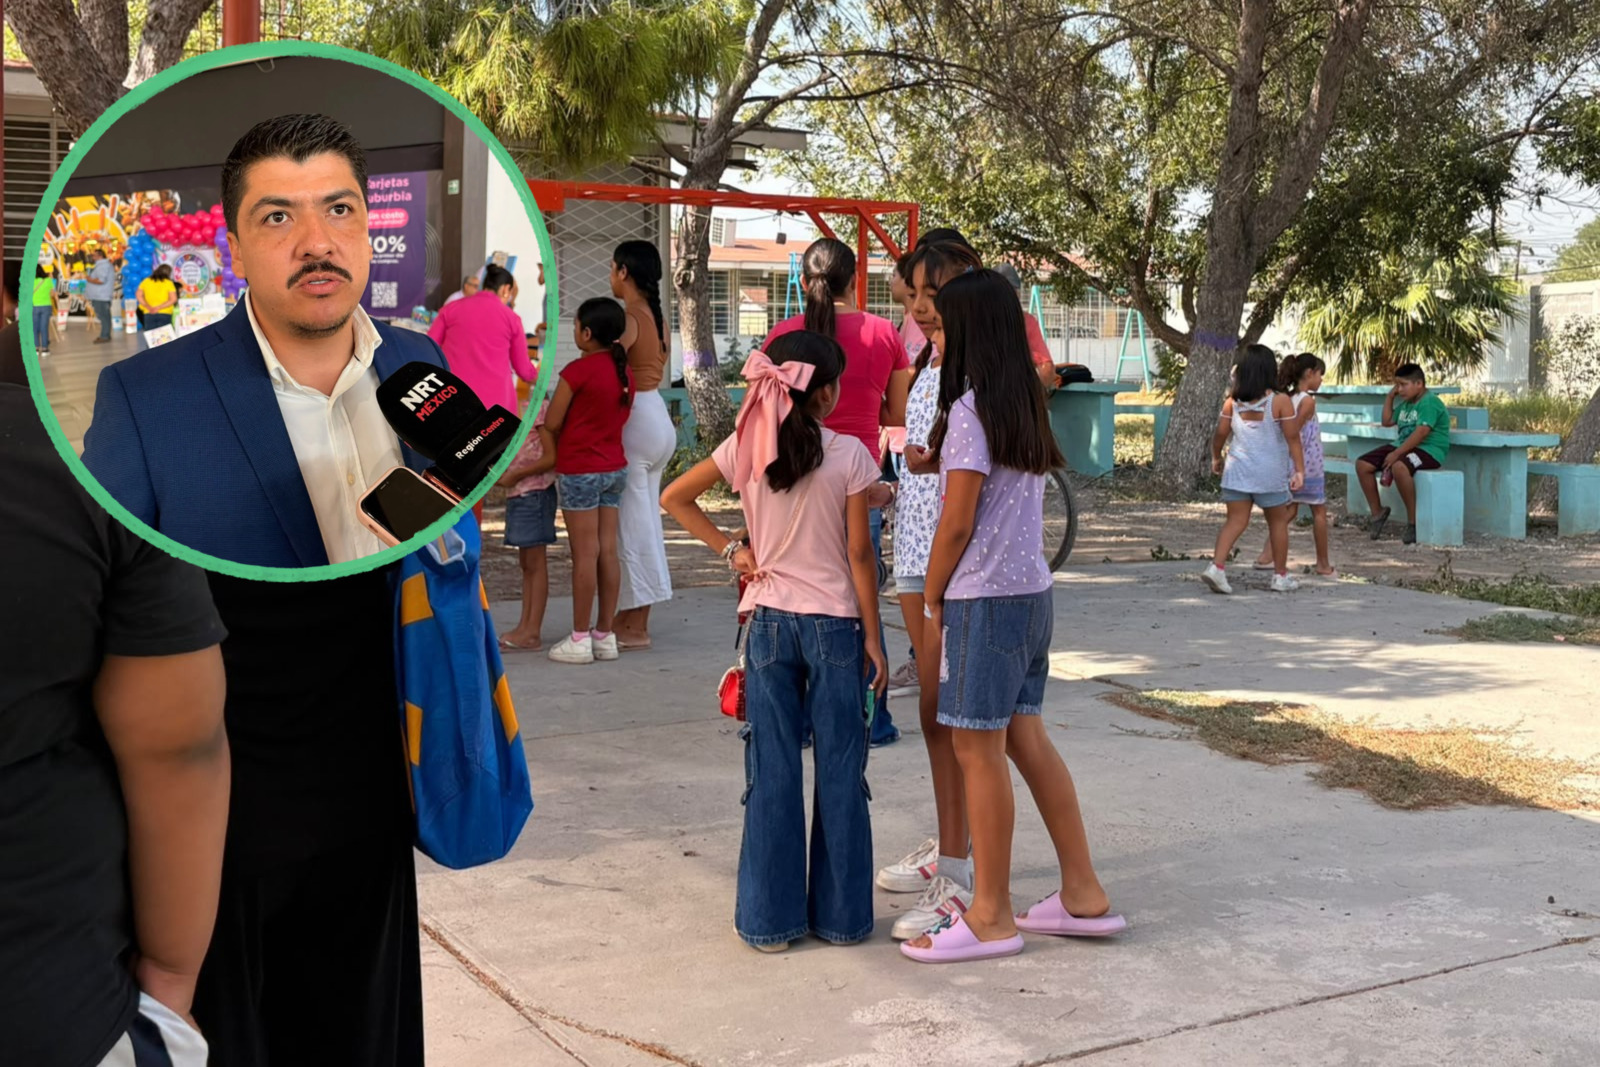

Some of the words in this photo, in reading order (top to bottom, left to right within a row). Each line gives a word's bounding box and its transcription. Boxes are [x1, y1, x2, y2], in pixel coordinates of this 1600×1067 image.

[367, 177, 410, 190] arjetas
[367, 191, 413, 203] uburbia
[400, 372, 445, 412] NRT
[415, 385, 458, 422] MÉXICO
[454, 434, 484, 460] Región
[480, 417, 505, 437] Centro
